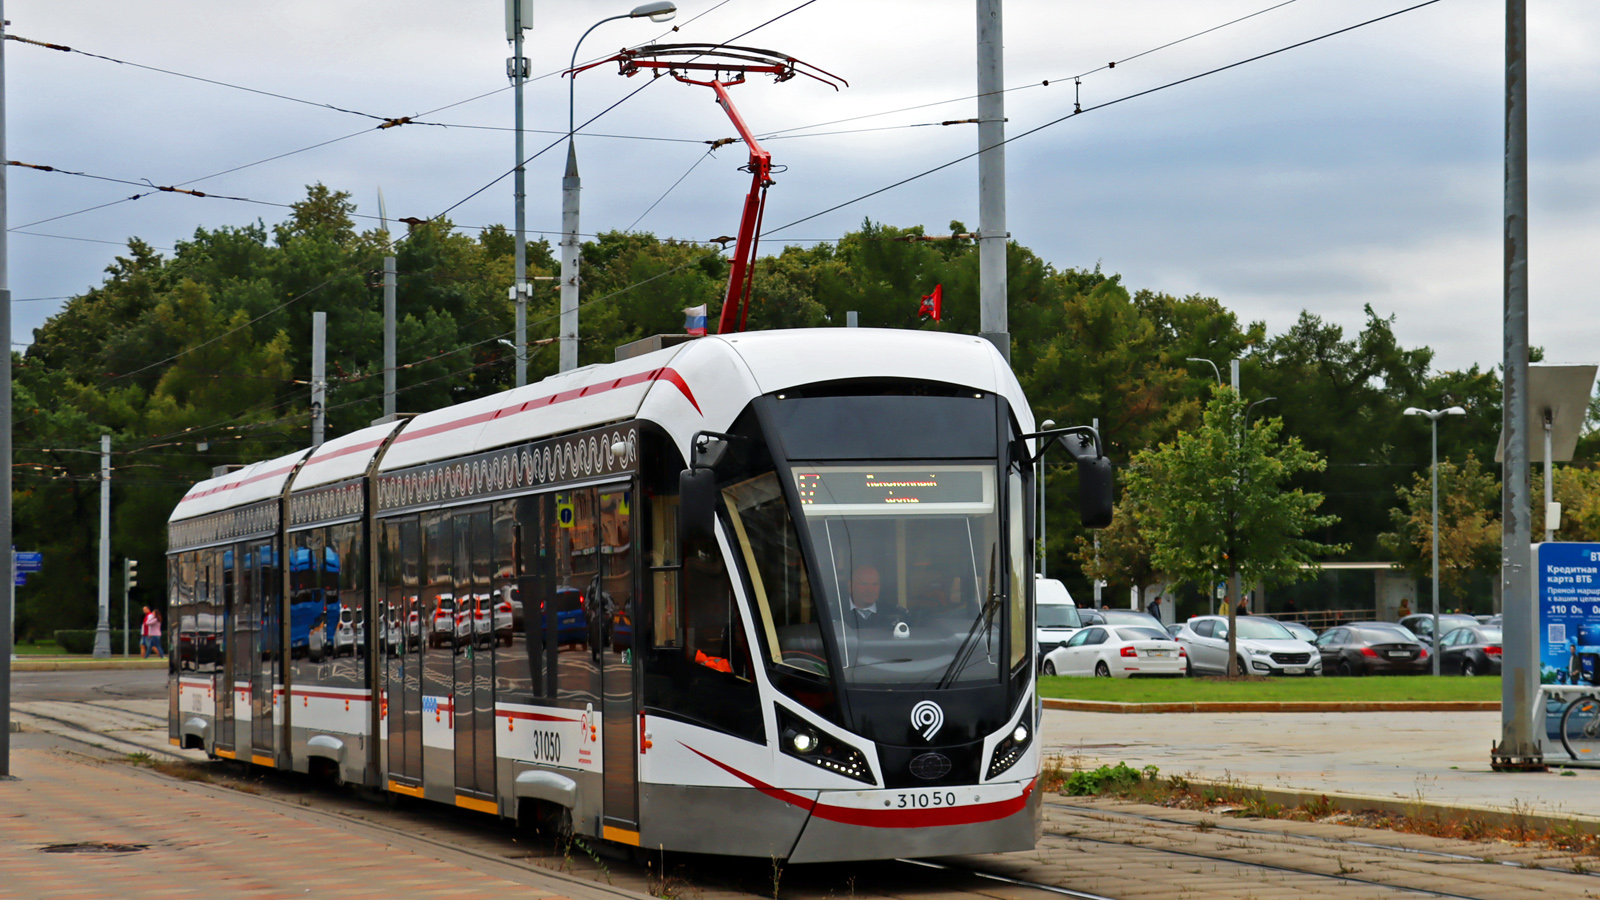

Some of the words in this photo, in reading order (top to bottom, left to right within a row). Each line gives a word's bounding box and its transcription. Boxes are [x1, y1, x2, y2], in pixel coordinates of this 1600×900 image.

[1547, 564, 1598, 575] Кредитная
[1547, 576, 1574, 585] карта
[1575, 574, 1593, 583] ВТБ
[1547, 586, 1576, 595] Прямой
[533, 729, 561, 763] 31050
[897, 791, 956, 808] 31050
